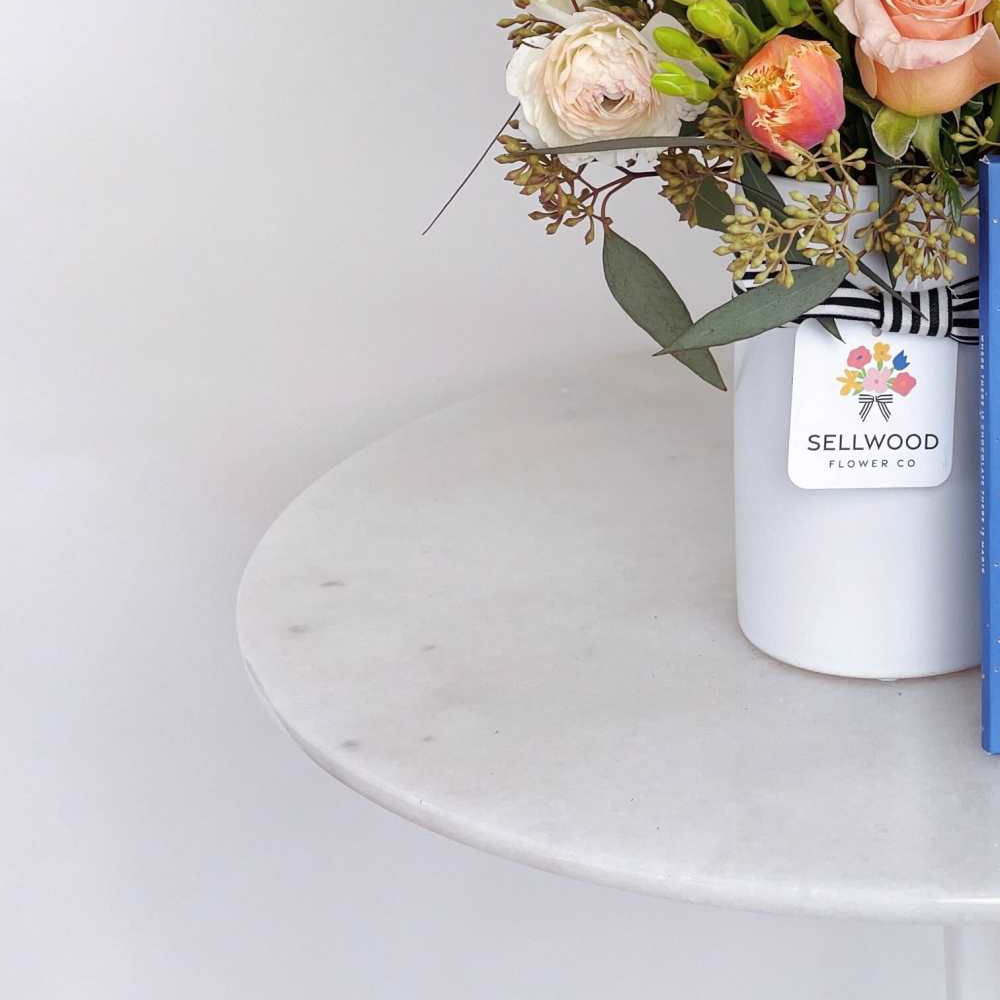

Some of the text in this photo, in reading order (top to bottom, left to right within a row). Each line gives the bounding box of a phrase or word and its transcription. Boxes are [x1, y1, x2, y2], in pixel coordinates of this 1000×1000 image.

[807, 433, 940, 452] SELLWOOD
[828, 458, 917, 469] FLOWER CO
